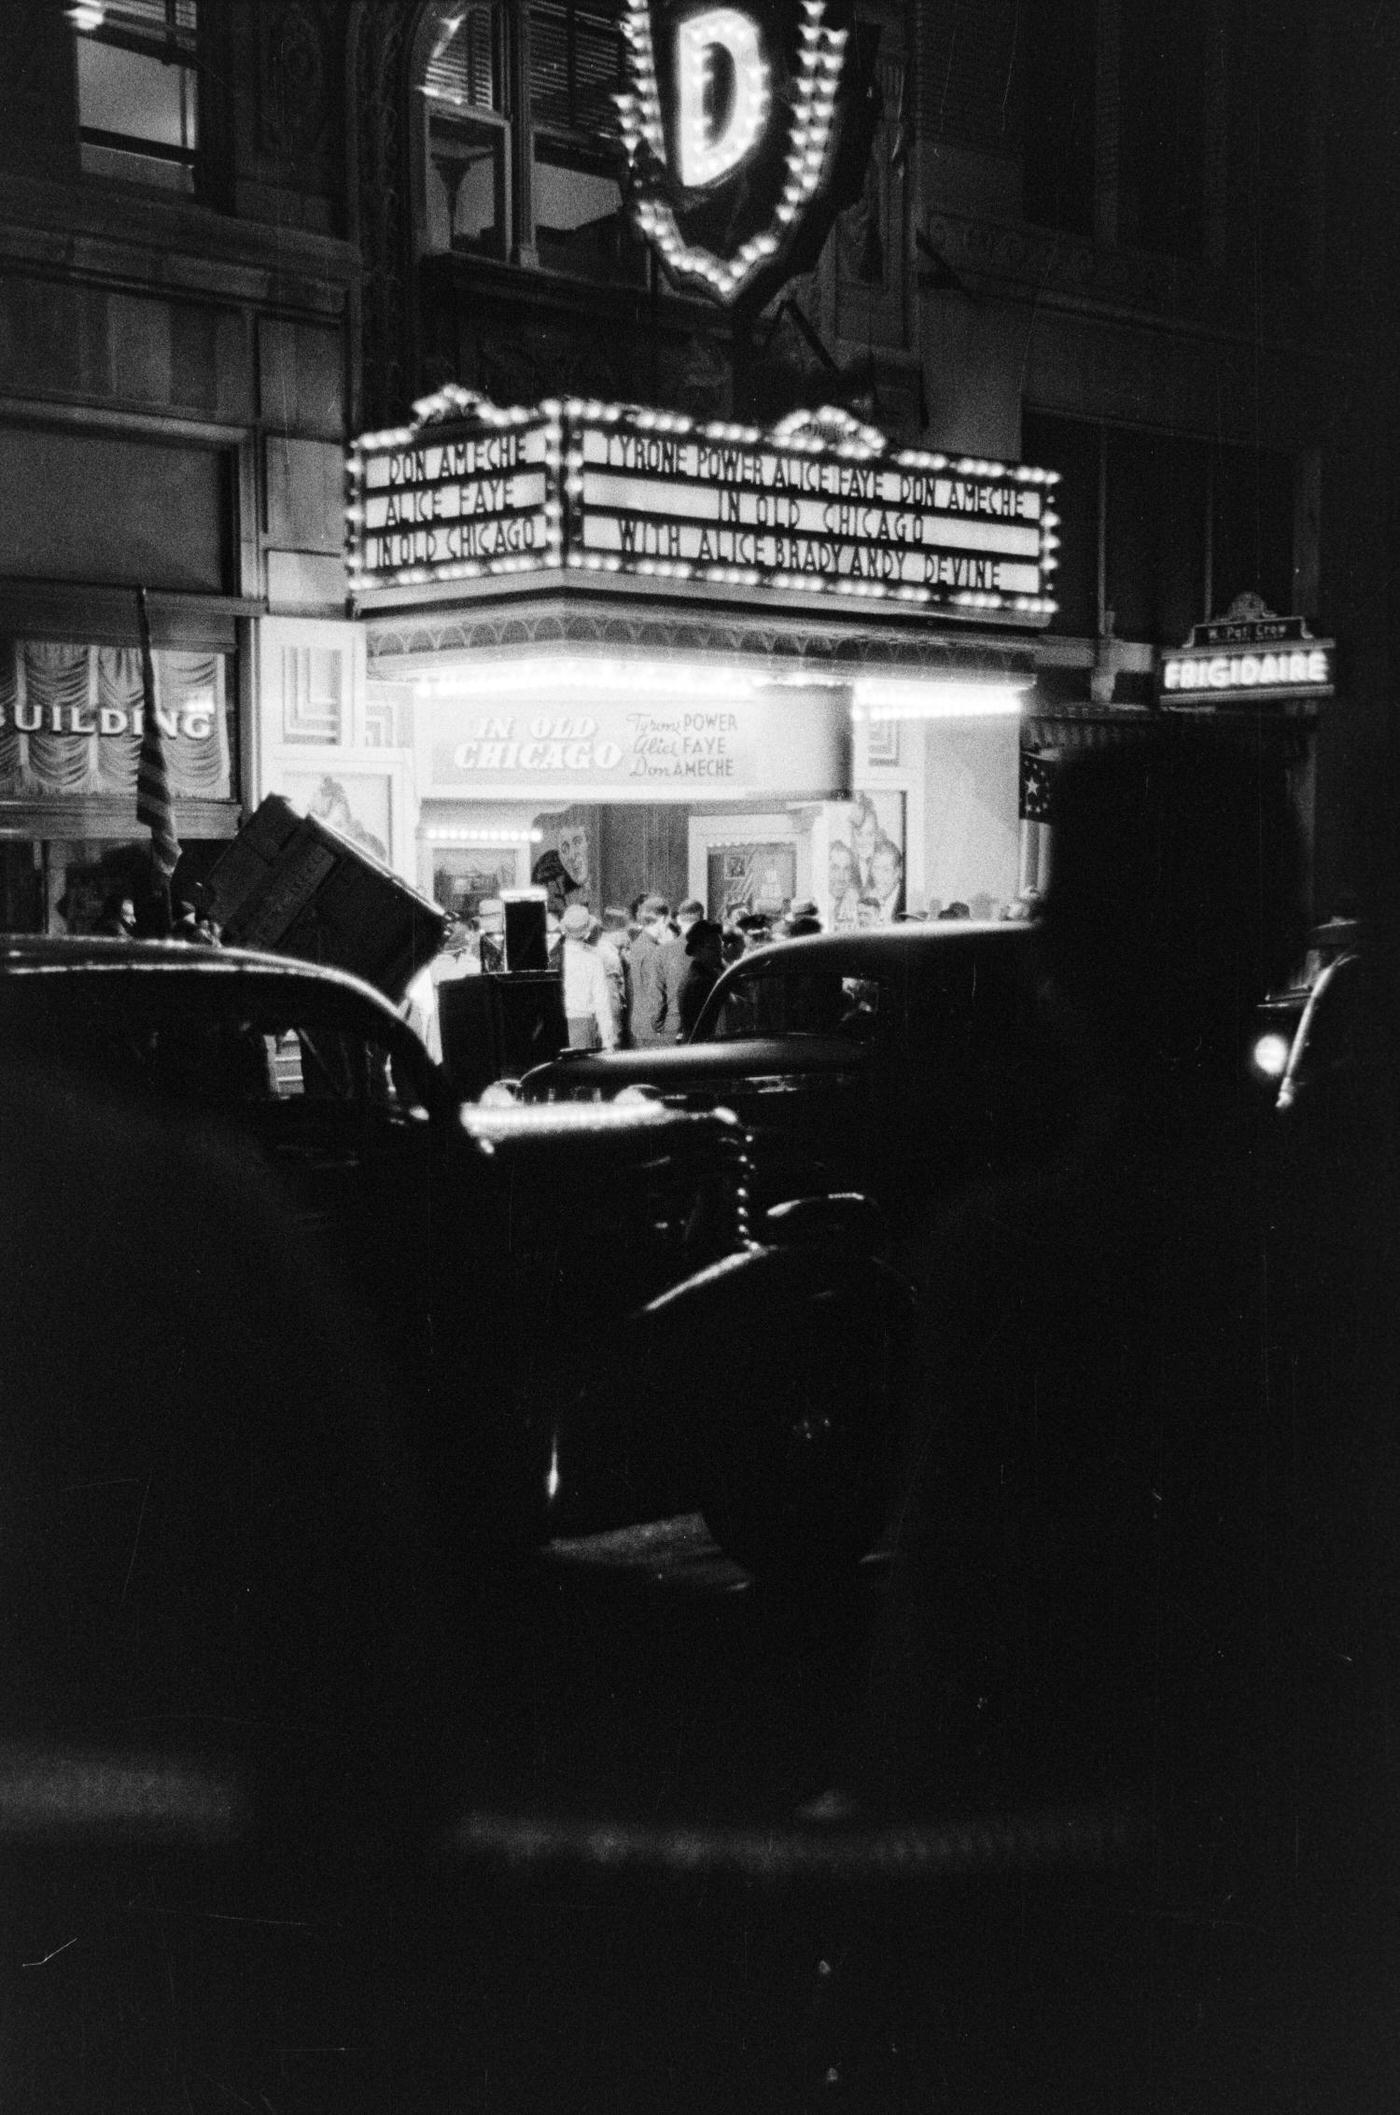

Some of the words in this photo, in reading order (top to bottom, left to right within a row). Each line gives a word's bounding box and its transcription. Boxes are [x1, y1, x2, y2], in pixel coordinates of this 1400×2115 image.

[678, 8, 770, 186] D
[389, 450, 426, 485] DON
[440, 433, 526, 477] AMECHE
[603, 433, 687, 473] TYRONE
[699, 445, 763, 483] POWER
[774, 456, 829, 493] ALICE
[839, 466, 883, 499] FAYE
[901, 475, 936, 507] DON
[950, 480, 1024, 517] AMECHE
[387, 489, 442, 526] ALICE
[460, 477, 514, 514] FAYE
[719, 489, 740, 522] IN
[757, 494, 801, 528] OLD
[823, 503, 923, 542] CHICAGO
[377, 536, 393, 567] IN
[400, 530, 437, 565] OLD
[447, 516, 535, 559] CHICAGO
[620, 518, 681, 556] WITH
[700, 527, 765, 564] ALICE
[775, 533, 842, 573] BRADY
[852, 545, 906, 579] ANDY
[925, 551, 1002, 589] DEVINE
[1164, 650, 1328, 689] FRIGIDAIRE
[0, 702, 212, 740] UILDING
[473, 716, 516, 740] IN
[530, 716, 600, 740] OLD
[684, 713, 738, 731] POWER
[454, 742, 624, 769] CHICAGO
[630, 758, 671, 777] Don
[673, 759, 734, 777] AMECHE
[682, 737, 726, 755] FAYE
